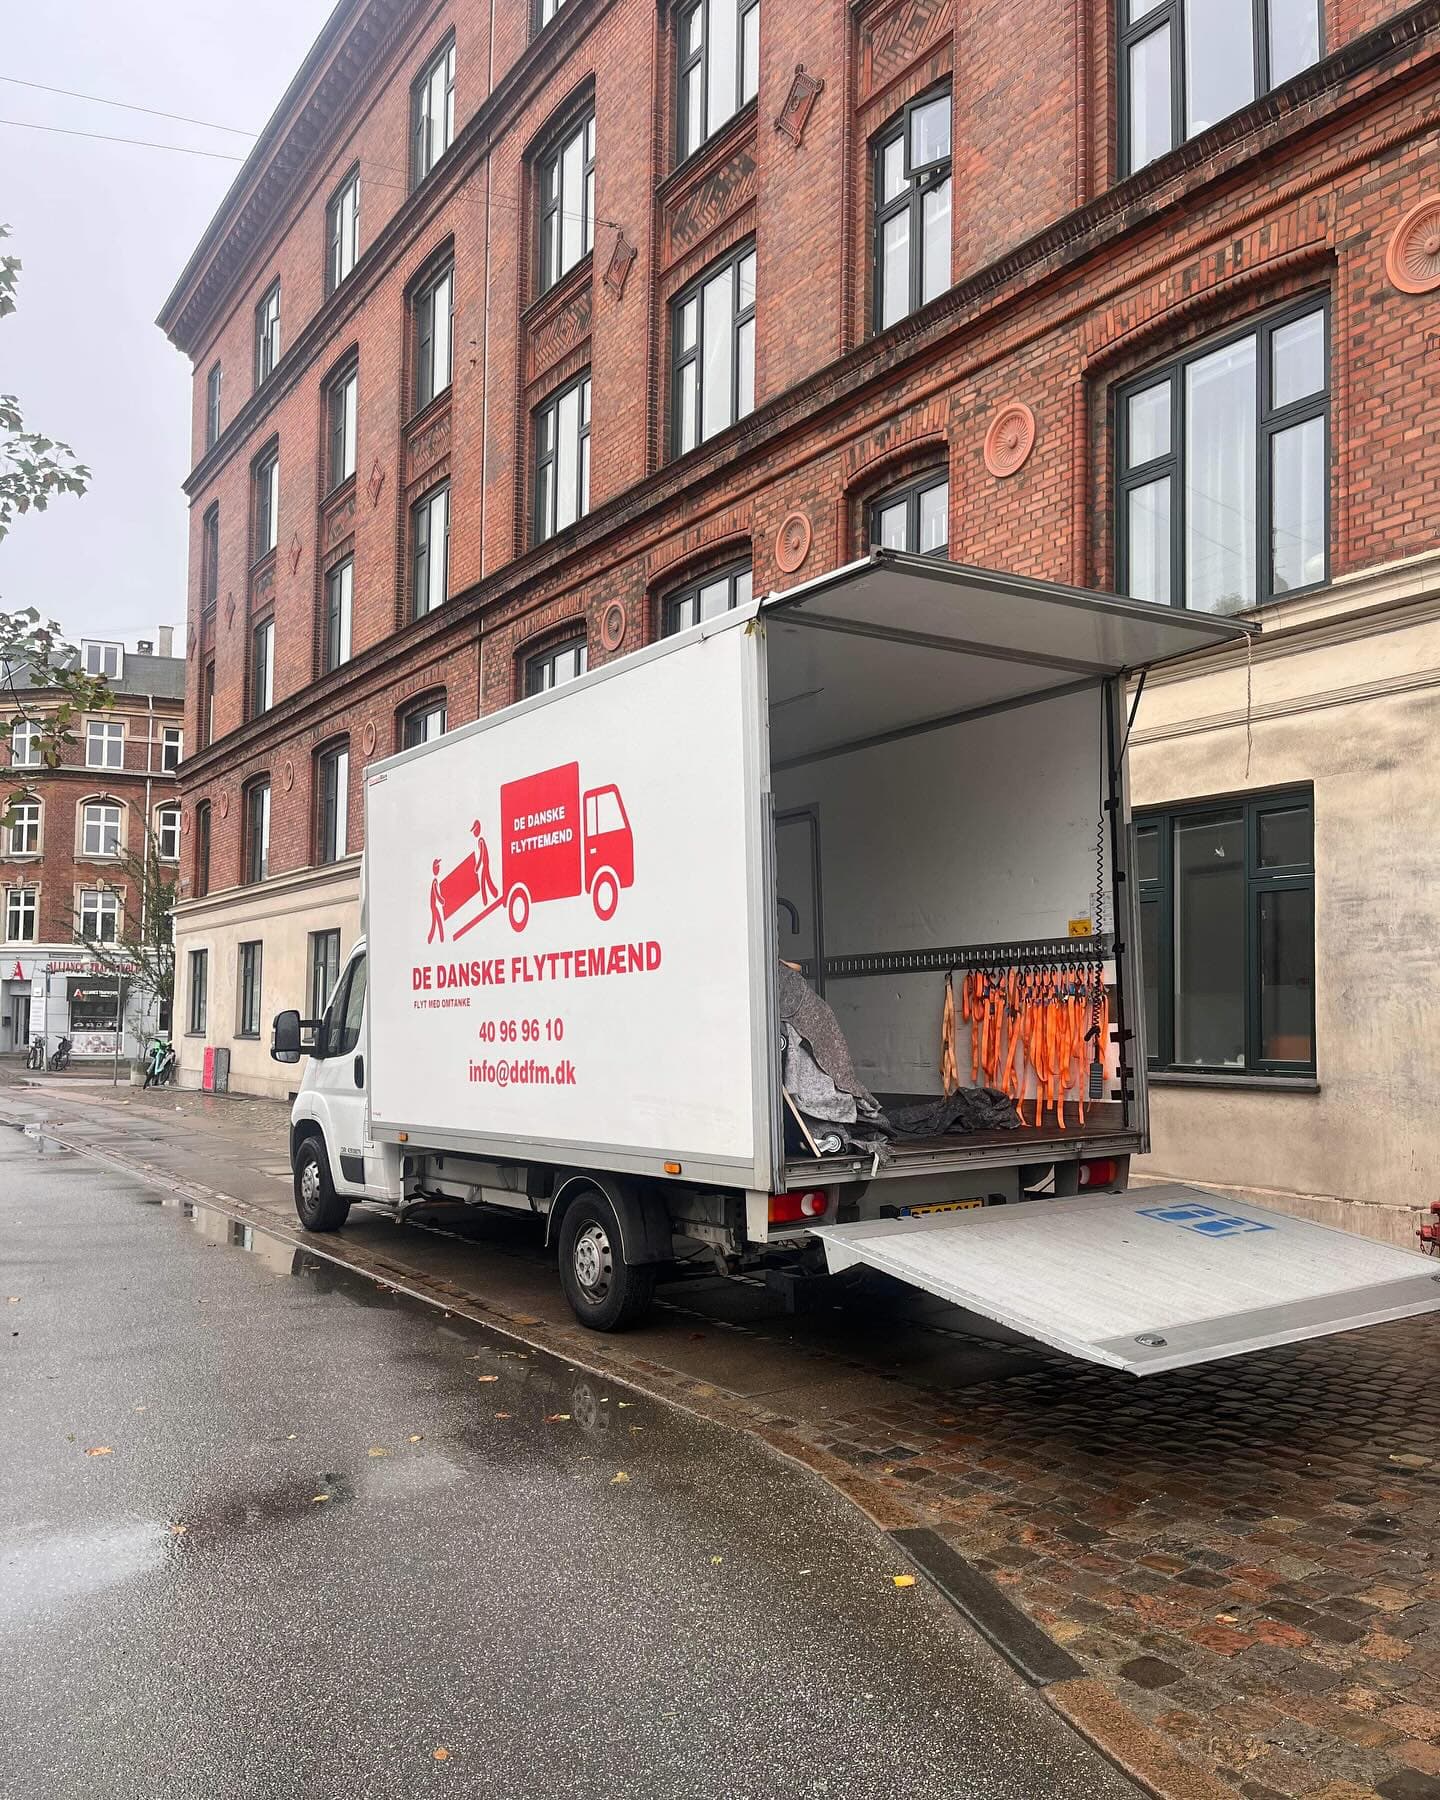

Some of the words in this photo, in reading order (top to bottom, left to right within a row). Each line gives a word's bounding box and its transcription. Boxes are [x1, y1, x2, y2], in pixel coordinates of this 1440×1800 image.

[514, 816, 526, 831] DE
[528, 806, 565, 828] DANSKE
[511, 828, 573, 854] FLYTTEMÆND
[412, 966, 432, 990] DE
[436, 958, 505, 989] DANSKE
[511, 940, 662, 983] FLYTTEMÆND
[413, 1000, 427, 1009] FLYT
[428, 999, 441, 1008] MED
[441, 997, 471, 1008] OMTANKE
[479, 1021, 496, 1042] 40
[499, 1019, 517, 1042] 96
[521, 1018, 540, 1042] 96
[546, 1017, 564, 1041] 10
[469, 1059, 576, 1088] info@ddfm.dk
